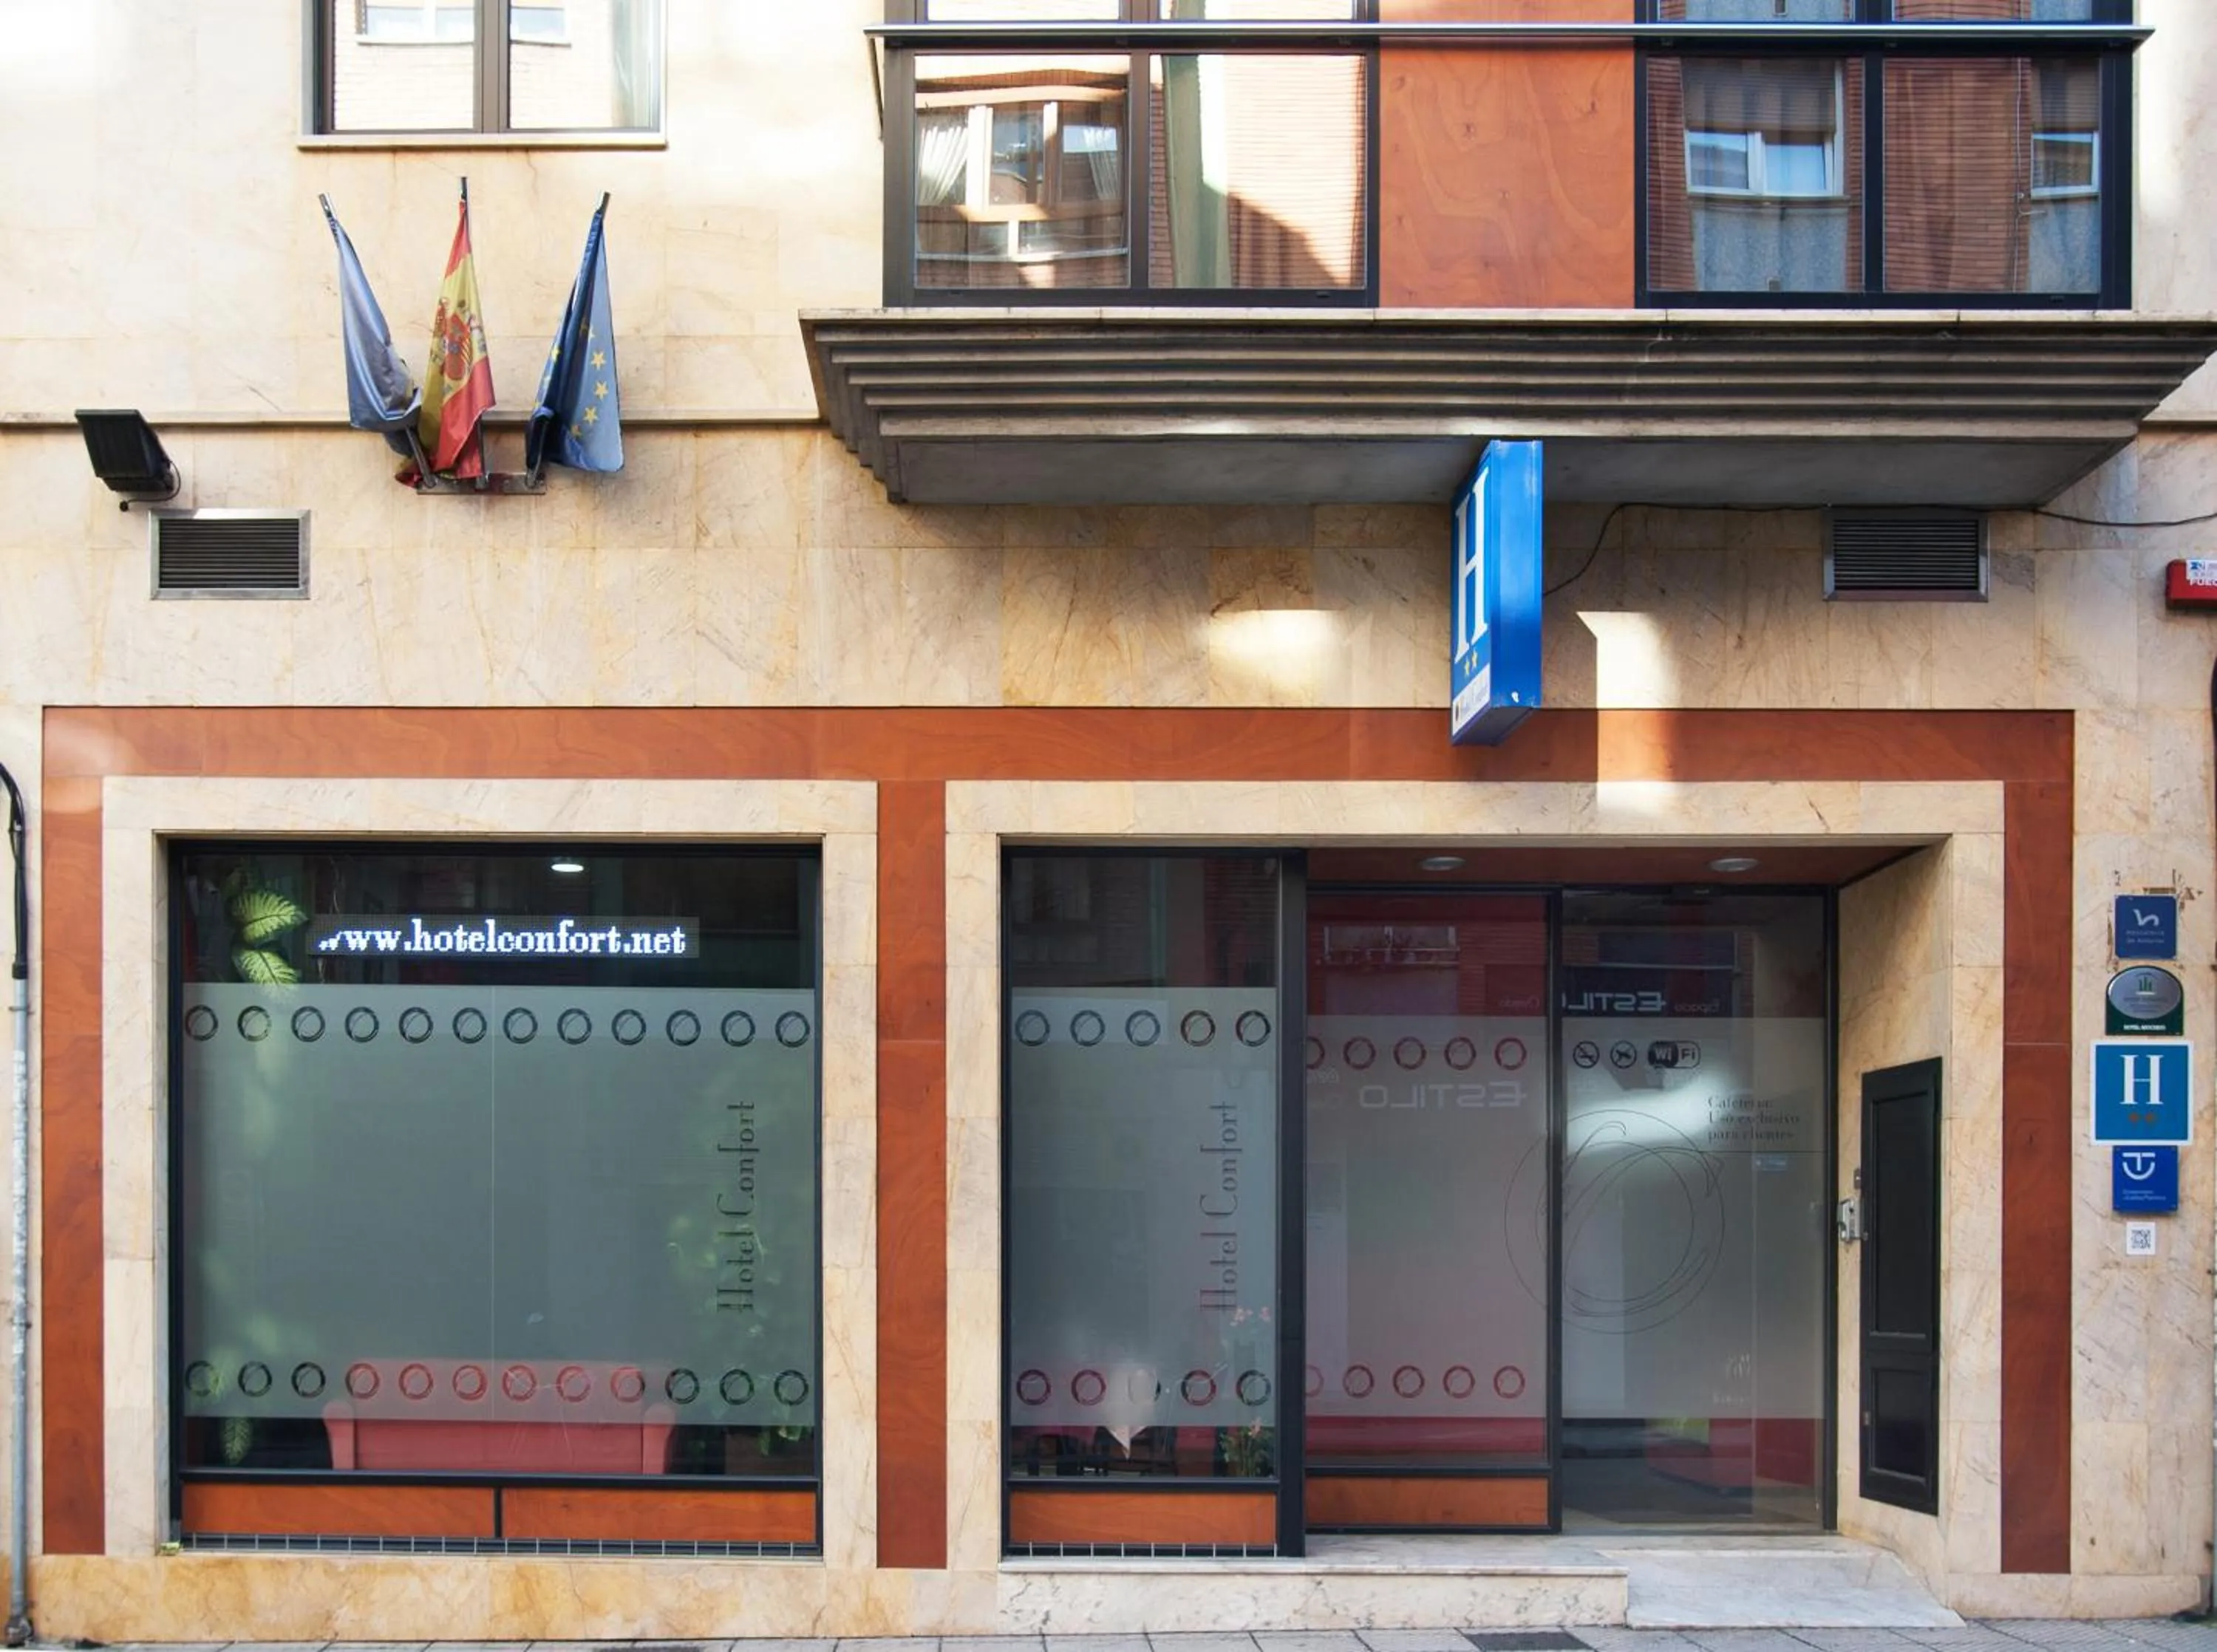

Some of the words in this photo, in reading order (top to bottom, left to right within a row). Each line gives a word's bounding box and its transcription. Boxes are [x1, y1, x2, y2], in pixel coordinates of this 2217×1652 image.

[1454, 467, 1489, 663] H
[2119, 1054, 2164, 1105] H
[717, 1101, 760, 1216] Confort
[1199, 1101, 1242, 1216] Confort
[717, 1231, 754, 1313] Hotel
[1199, 1232, 1237, 1313] Hotel
